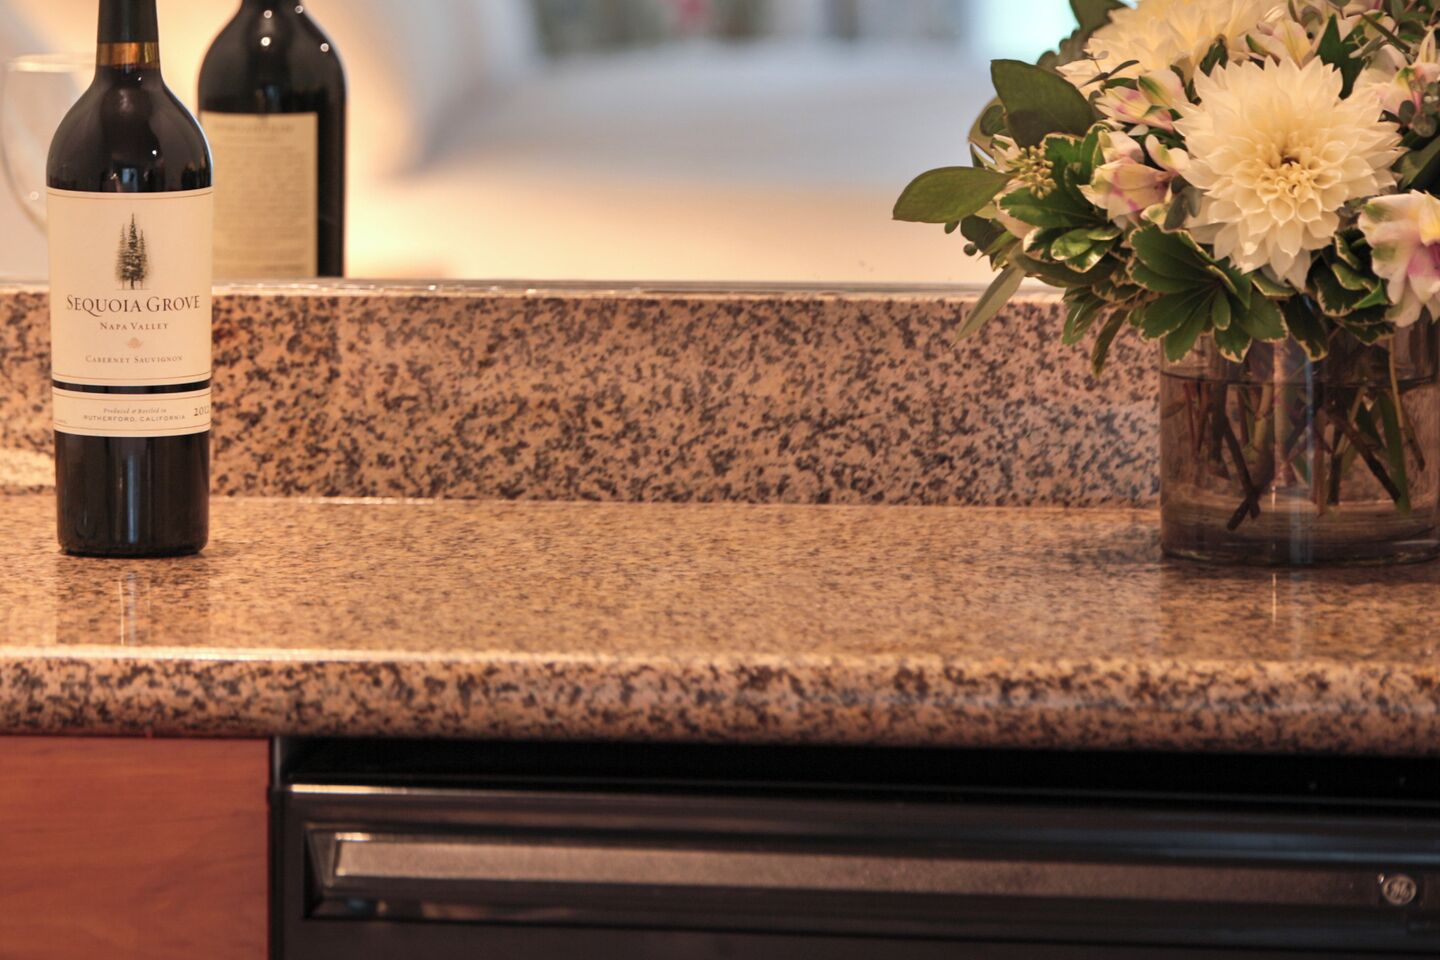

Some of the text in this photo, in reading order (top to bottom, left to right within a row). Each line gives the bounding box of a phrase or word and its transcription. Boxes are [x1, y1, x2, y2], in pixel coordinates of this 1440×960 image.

[66, 294, 200, 317] SEQUOIA GROVE
[100, 322, 168, 330] NAPA VALLEY
[85, 355, 183, 363] CABERNET SAUVIGNON
